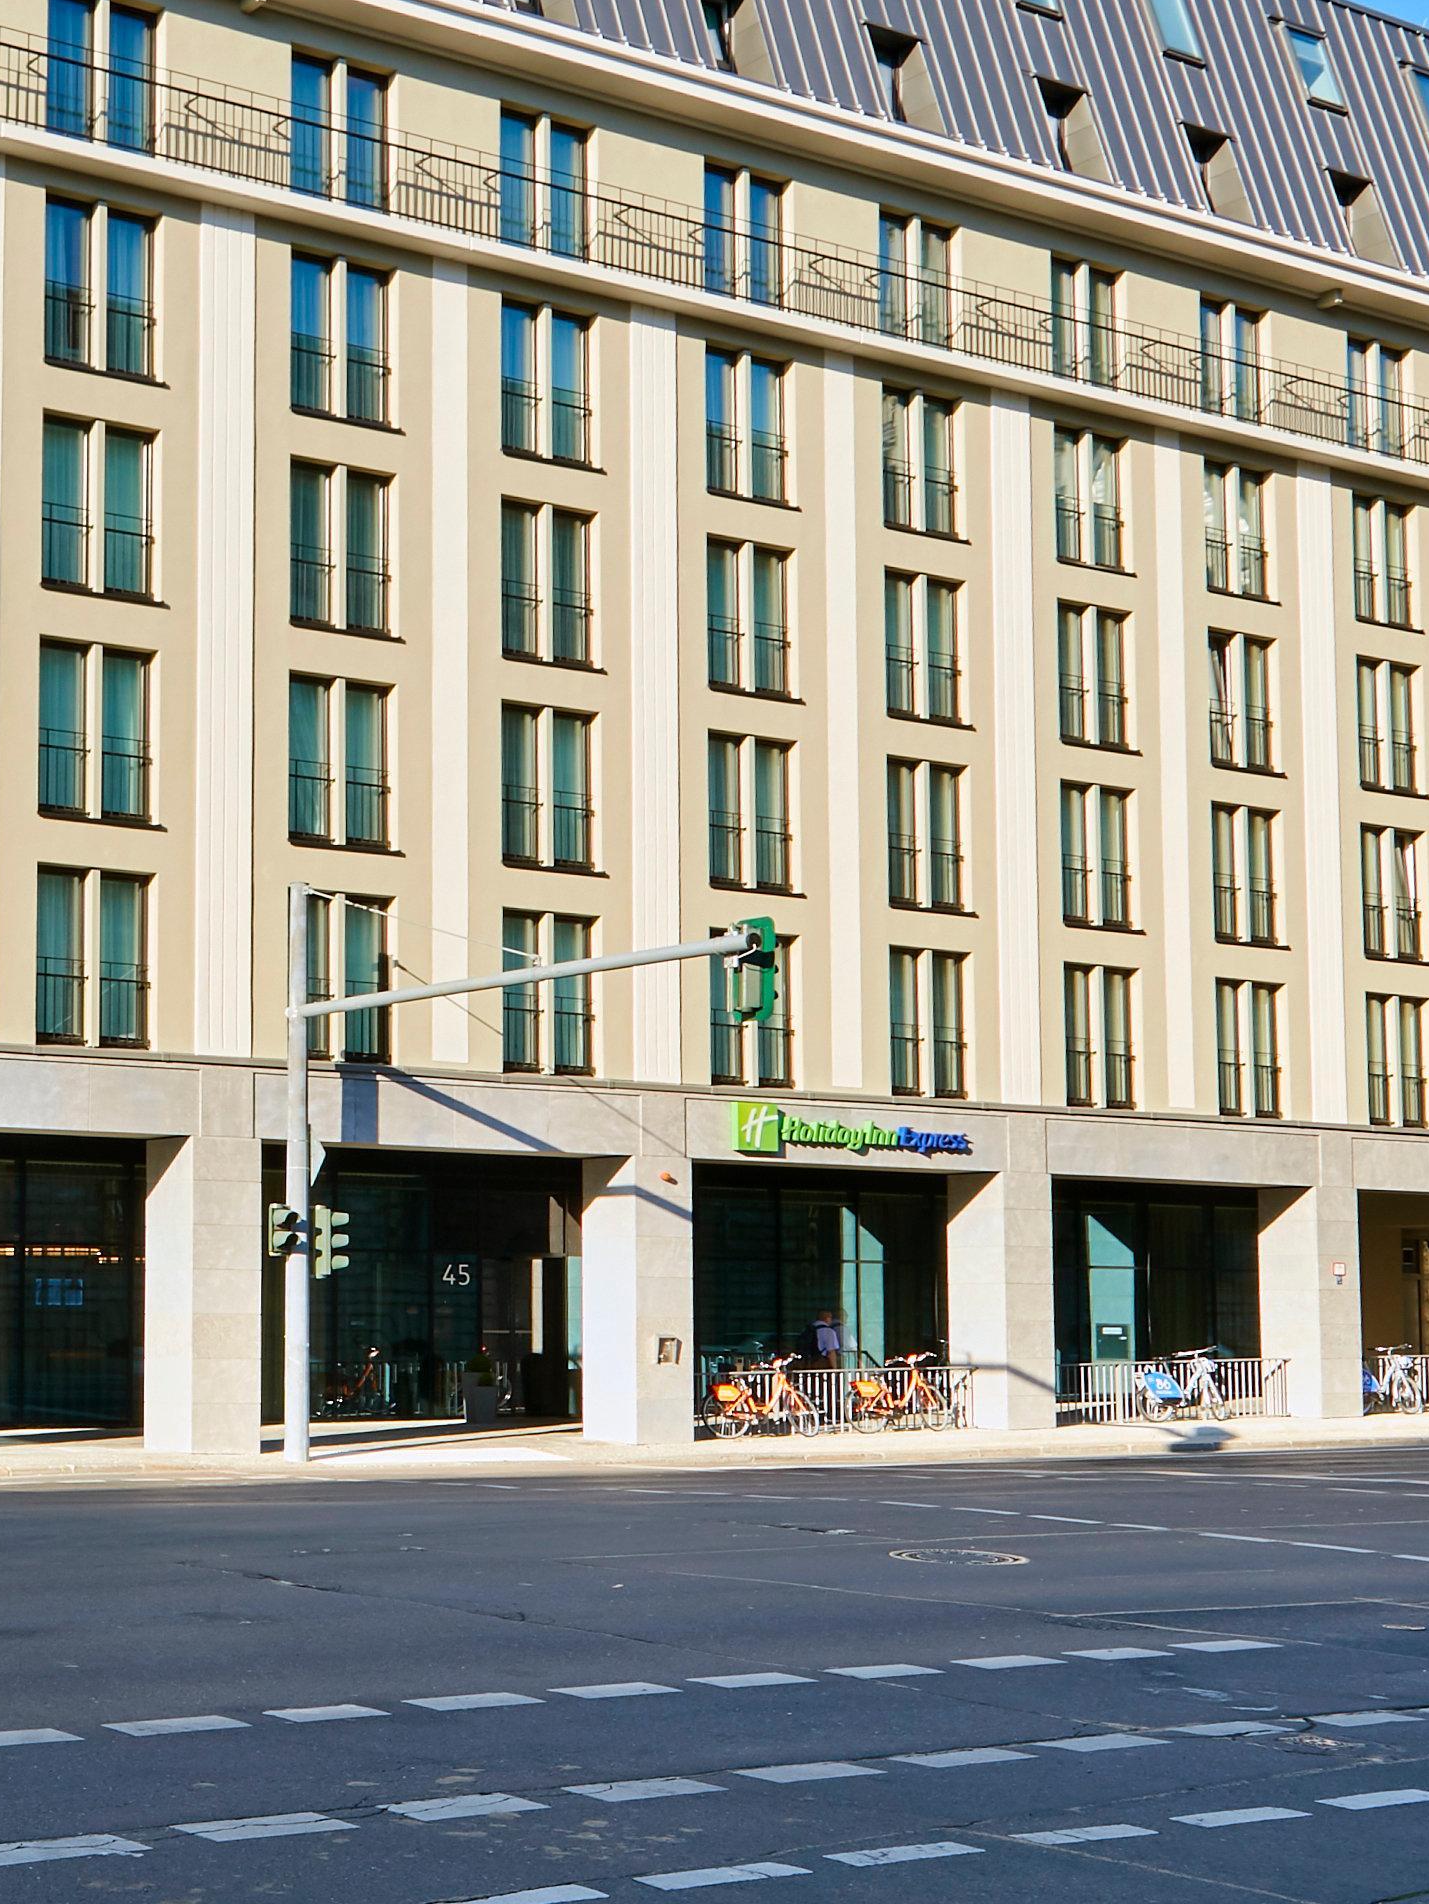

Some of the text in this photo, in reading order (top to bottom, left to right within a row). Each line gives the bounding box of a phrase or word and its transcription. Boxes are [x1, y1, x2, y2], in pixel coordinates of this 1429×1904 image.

[781, 1115, 970, 1153] Holiday Inn Express
[442, 1263, 471, 1286] 45
